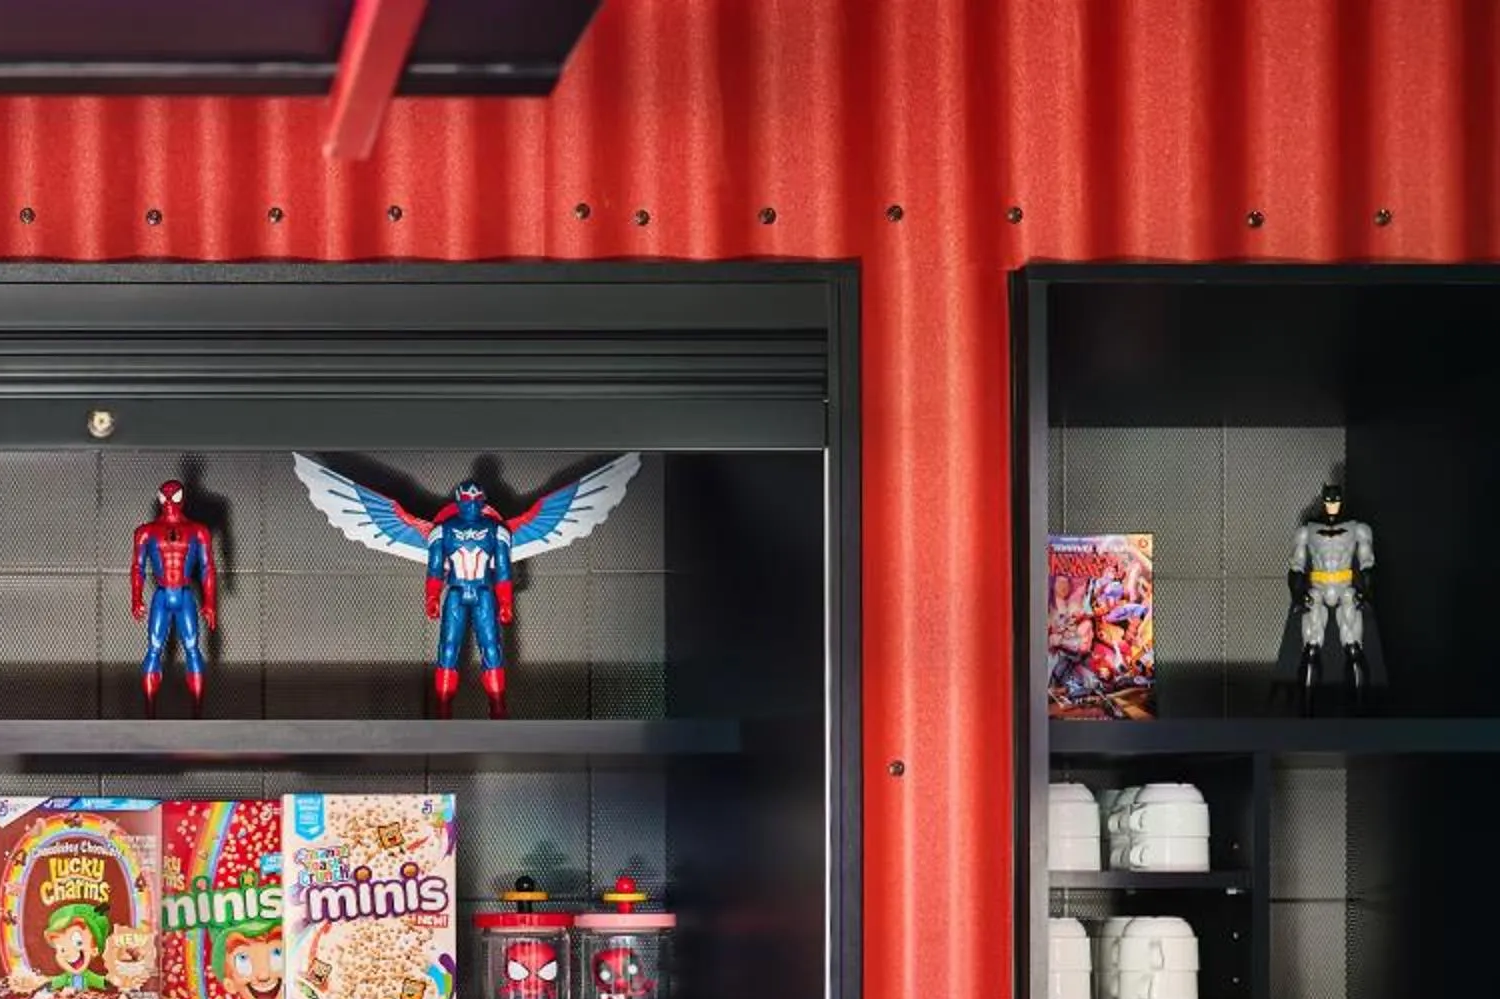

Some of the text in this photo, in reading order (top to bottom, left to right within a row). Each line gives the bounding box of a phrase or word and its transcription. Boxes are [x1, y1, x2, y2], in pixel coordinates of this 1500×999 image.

[49, 856, 106, 884] Lucky
[39, 879, 111, 906] Charms
[161, 872, 282, 928] minis
[308, 862, 448, 922] minis
